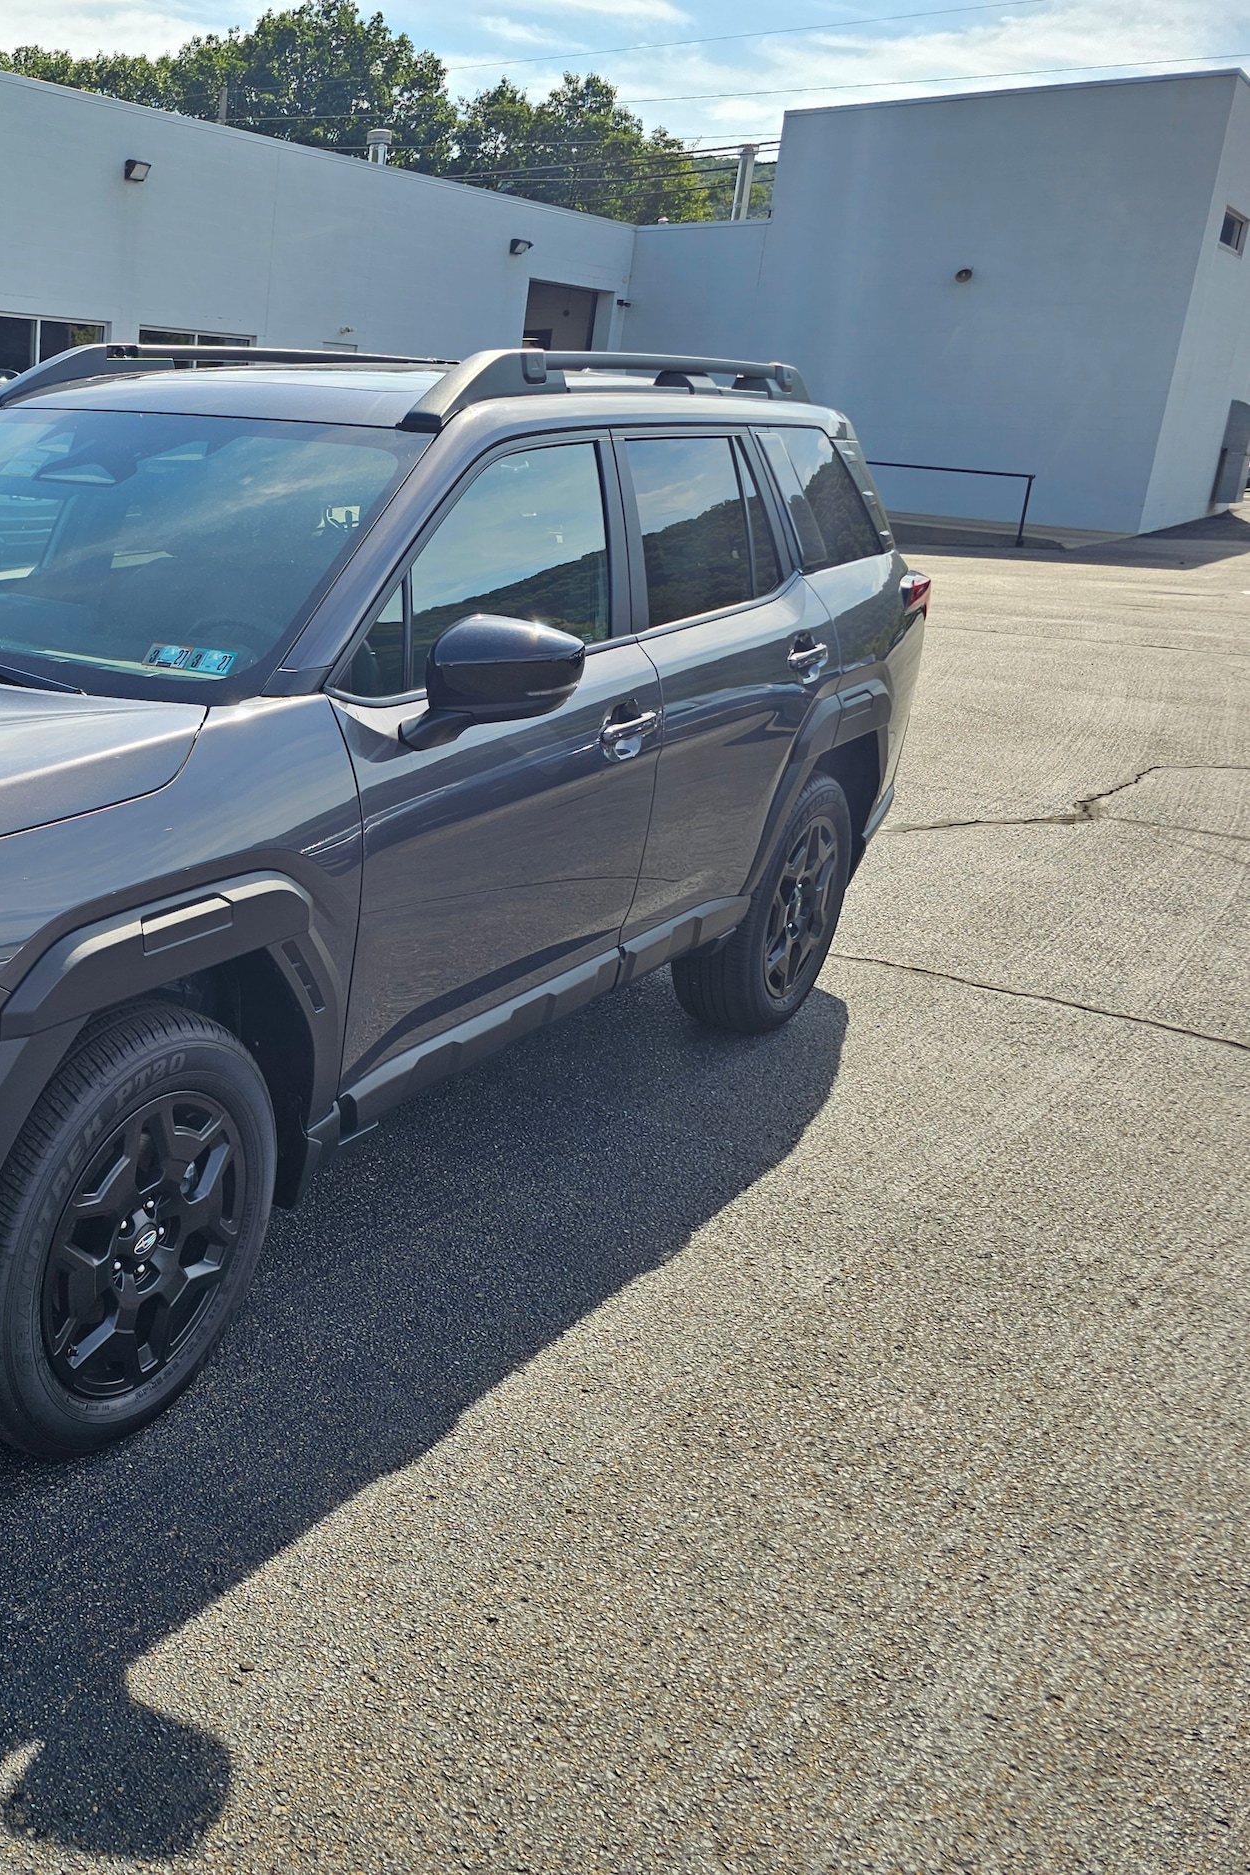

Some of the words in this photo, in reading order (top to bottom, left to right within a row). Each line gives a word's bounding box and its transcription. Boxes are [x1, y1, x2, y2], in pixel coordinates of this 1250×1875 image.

[149, 650, 160, 663] 3
[173, 650, 190, 666] 27
[191, 654, 202, 668] 3
[216, 655, 232, 672] 27
[14, 1111, 103, 1370] GRANDTREK
[114, 1052, 186, 1114] PT20
